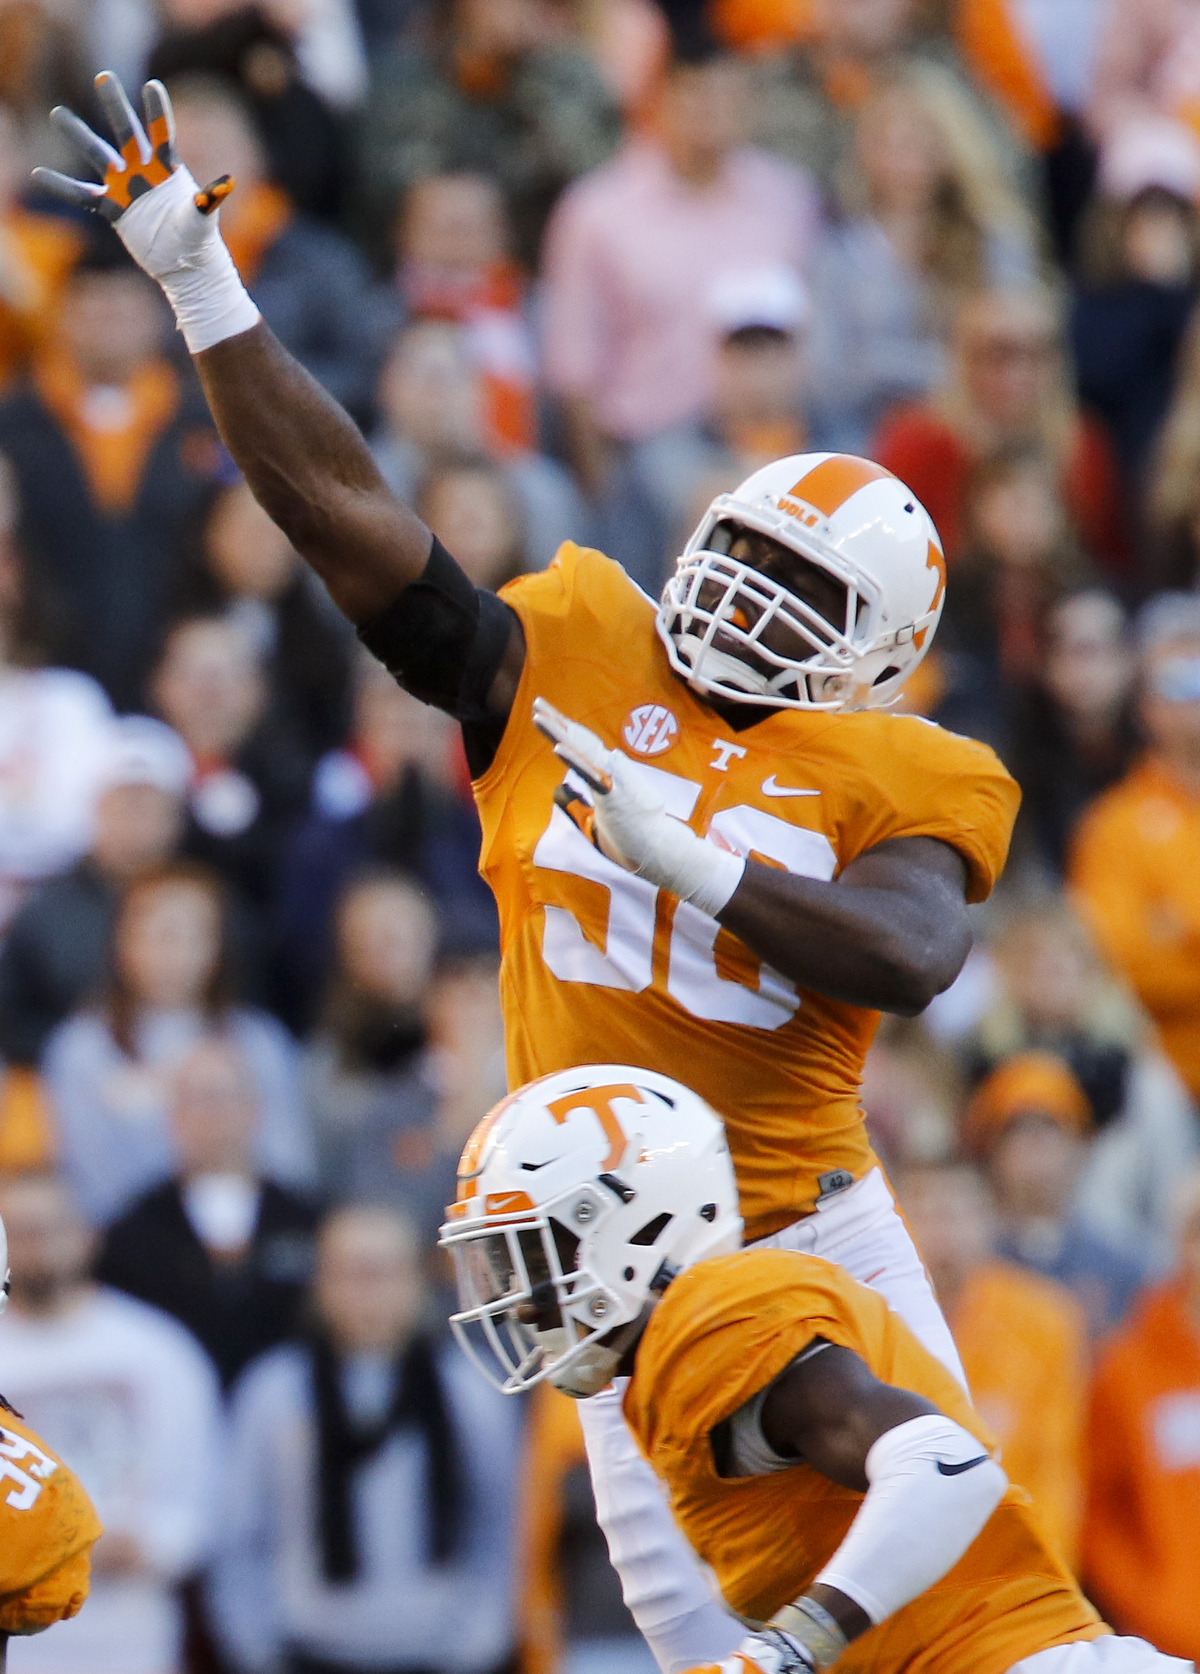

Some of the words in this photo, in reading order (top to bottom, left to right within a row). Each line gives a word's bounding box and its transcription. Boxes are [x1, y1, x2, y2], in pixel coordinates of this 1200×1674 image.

[623, 703, 678, 754] SEC
[710, 738, 747, 771] T
[547, 1083, 647, 1172] T
